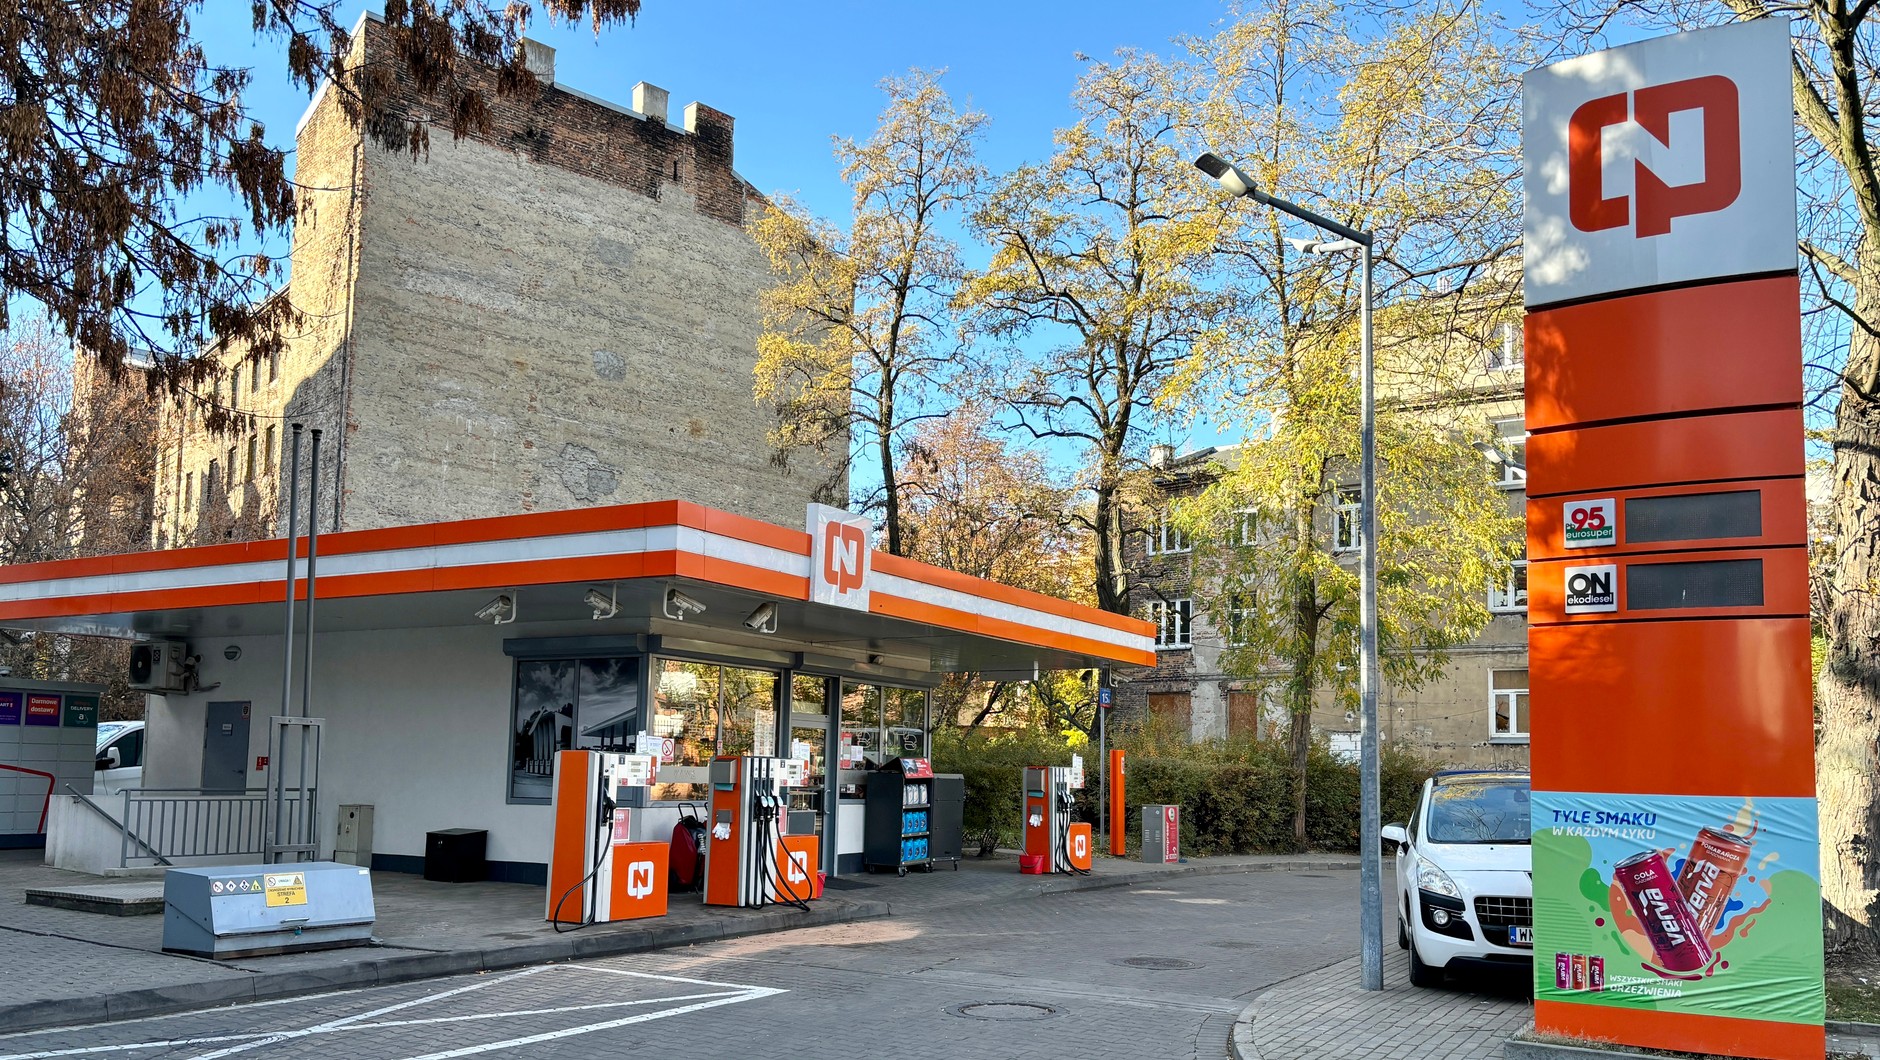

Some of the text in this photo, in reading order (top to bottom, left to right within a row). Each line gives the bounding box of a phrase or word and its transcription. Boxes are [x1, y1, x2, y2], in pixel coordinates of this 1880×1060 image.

[1571, 506, 1606, 531] 95
[1566, 528, 1612, 539] eurosuper
[1568, 572, 1611, 596] ON
[1567, 594, 1612, 604] ekodiesel
[30, 705, 54, 714] dostawy
[1552, 809, 1657, 826] TYLE SMAKU
[1552, 823, 1656, 840] W KAŻDYM ŁYKU
[1701, 841, 1740, 861] POMARAŃCZA
[1633, 869, 1656, 880] COLA
[1645, 888, 1686, 946] verva
